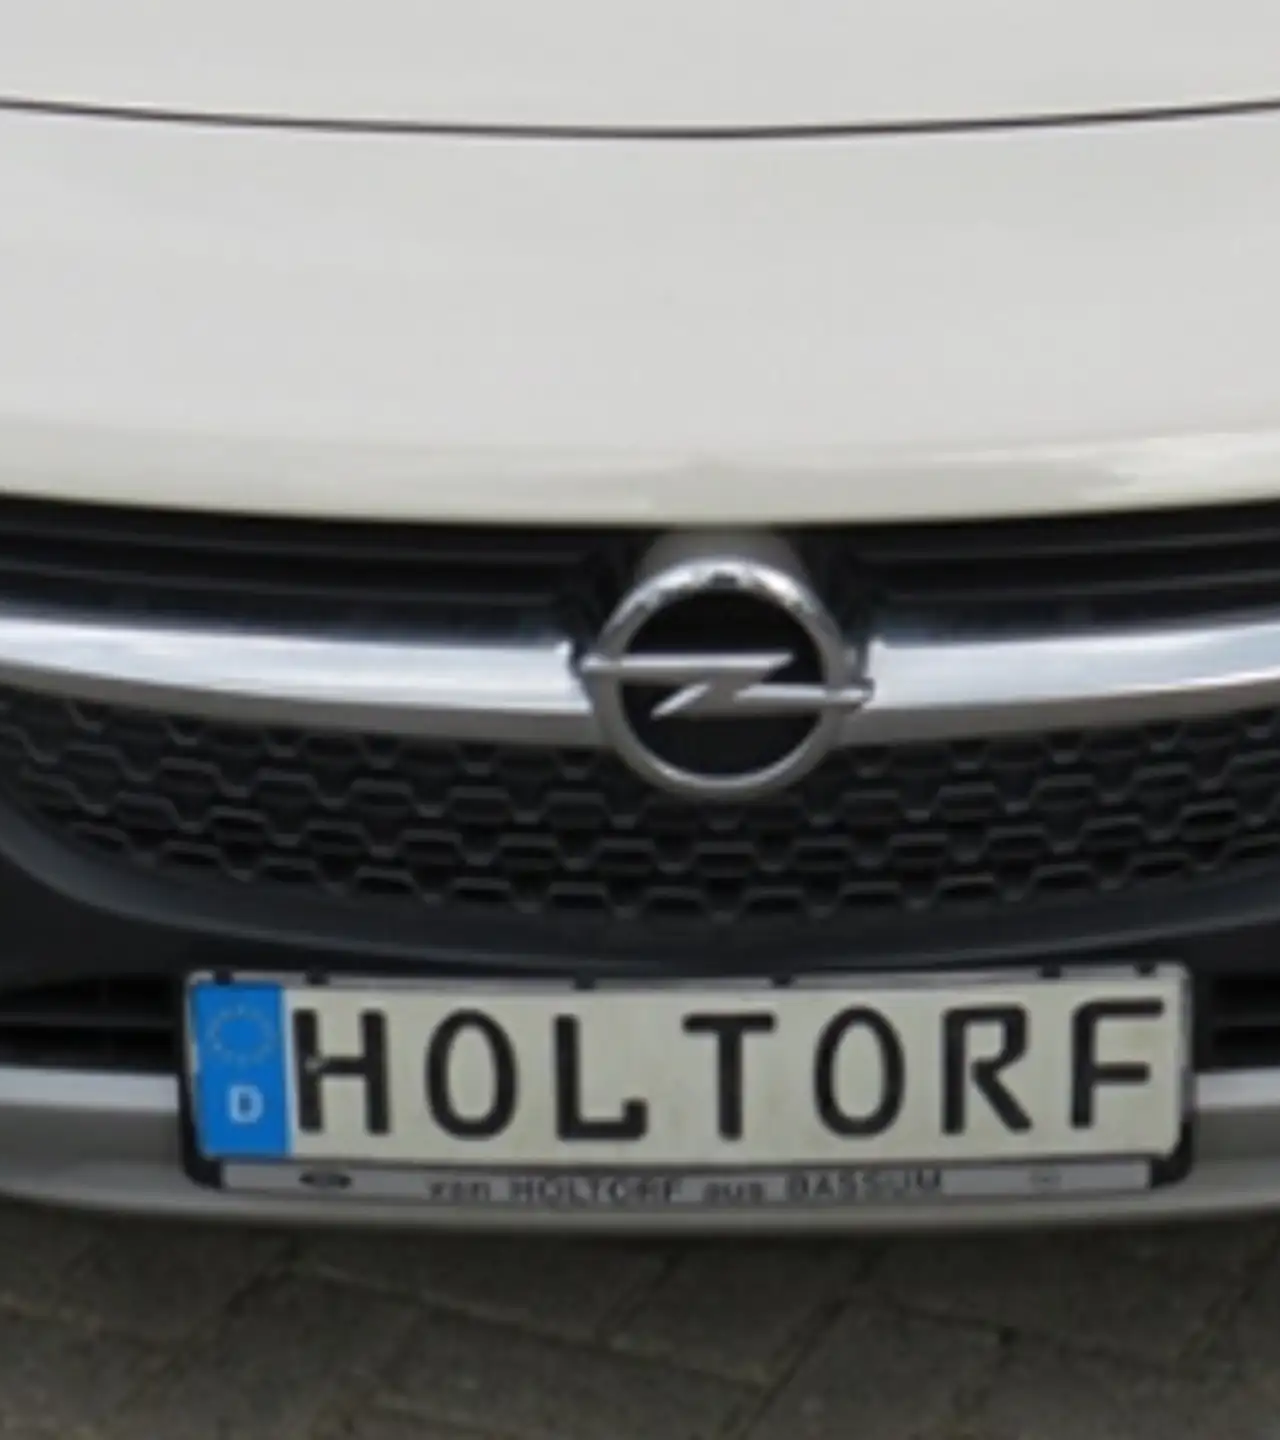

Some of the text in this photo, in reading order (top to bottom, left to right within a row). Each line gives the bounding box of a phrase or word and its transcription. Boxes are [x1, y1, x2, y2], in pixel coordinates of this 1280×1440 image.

[292, 998, 1165, 1141] HOLTORF
[228, 1084, 264, 1124] D
[511, 1175, 682, 1204] HOLTORF
